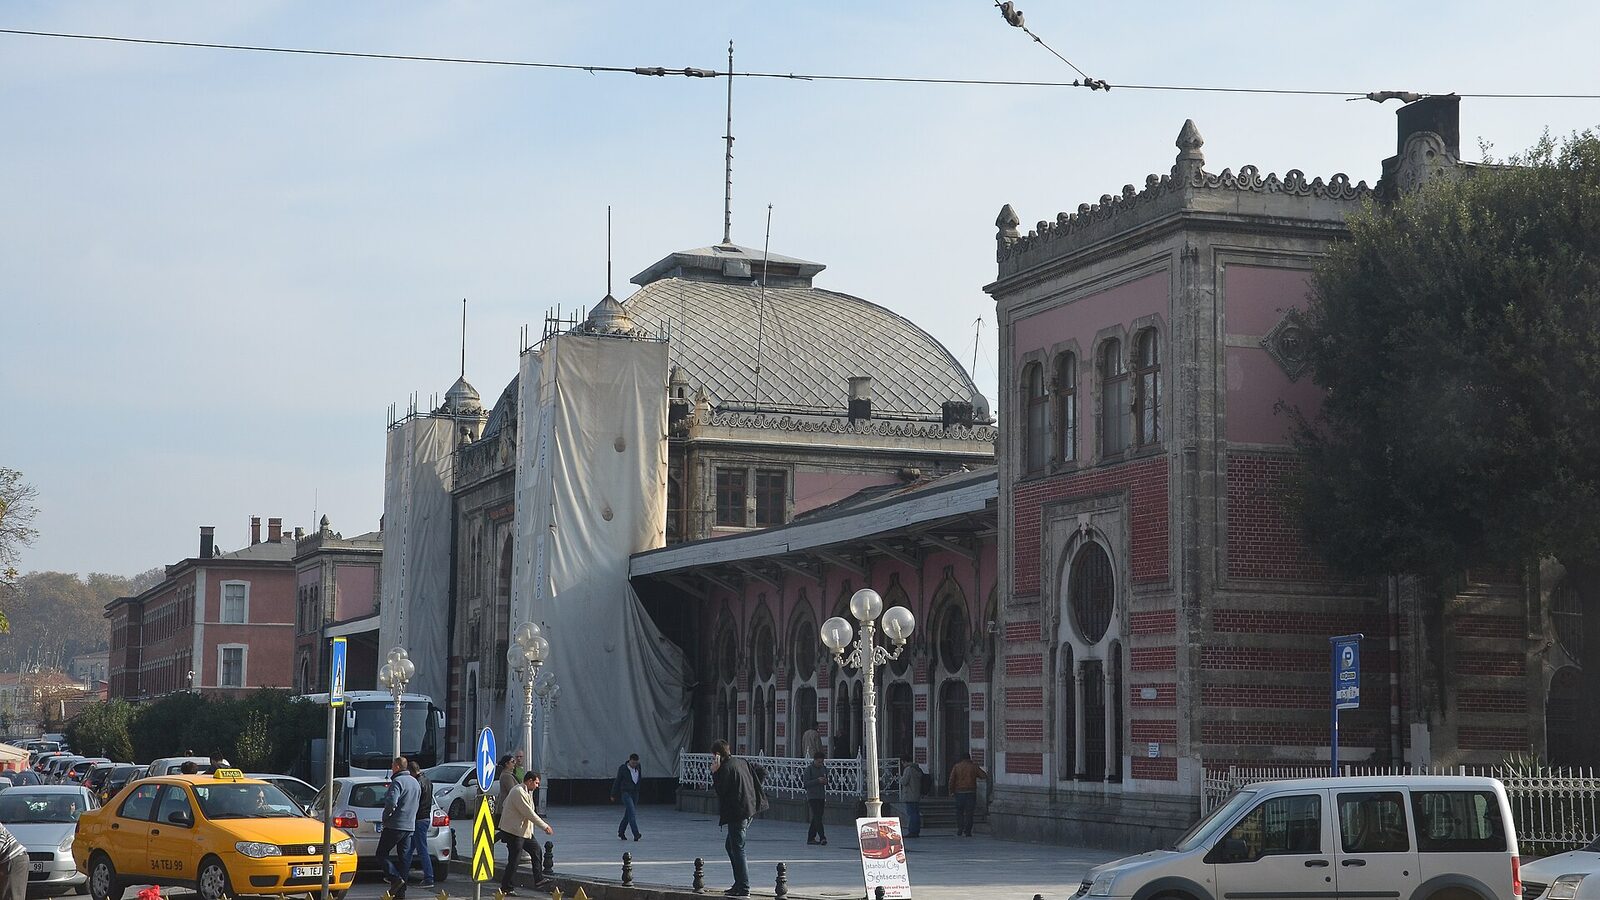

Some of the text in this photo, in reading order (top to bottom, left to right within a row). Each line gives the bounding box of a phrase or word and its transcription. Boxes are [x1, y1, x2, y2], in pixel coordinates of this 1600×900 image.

[151, 859, 183, 871] 34 TEJ 99
[887, 860, 900, 871] City
[297, 867, 305, 876] 34
[310, 867, 322, 875] TEJ
[867, 871, 907, 884] Sightseeing
